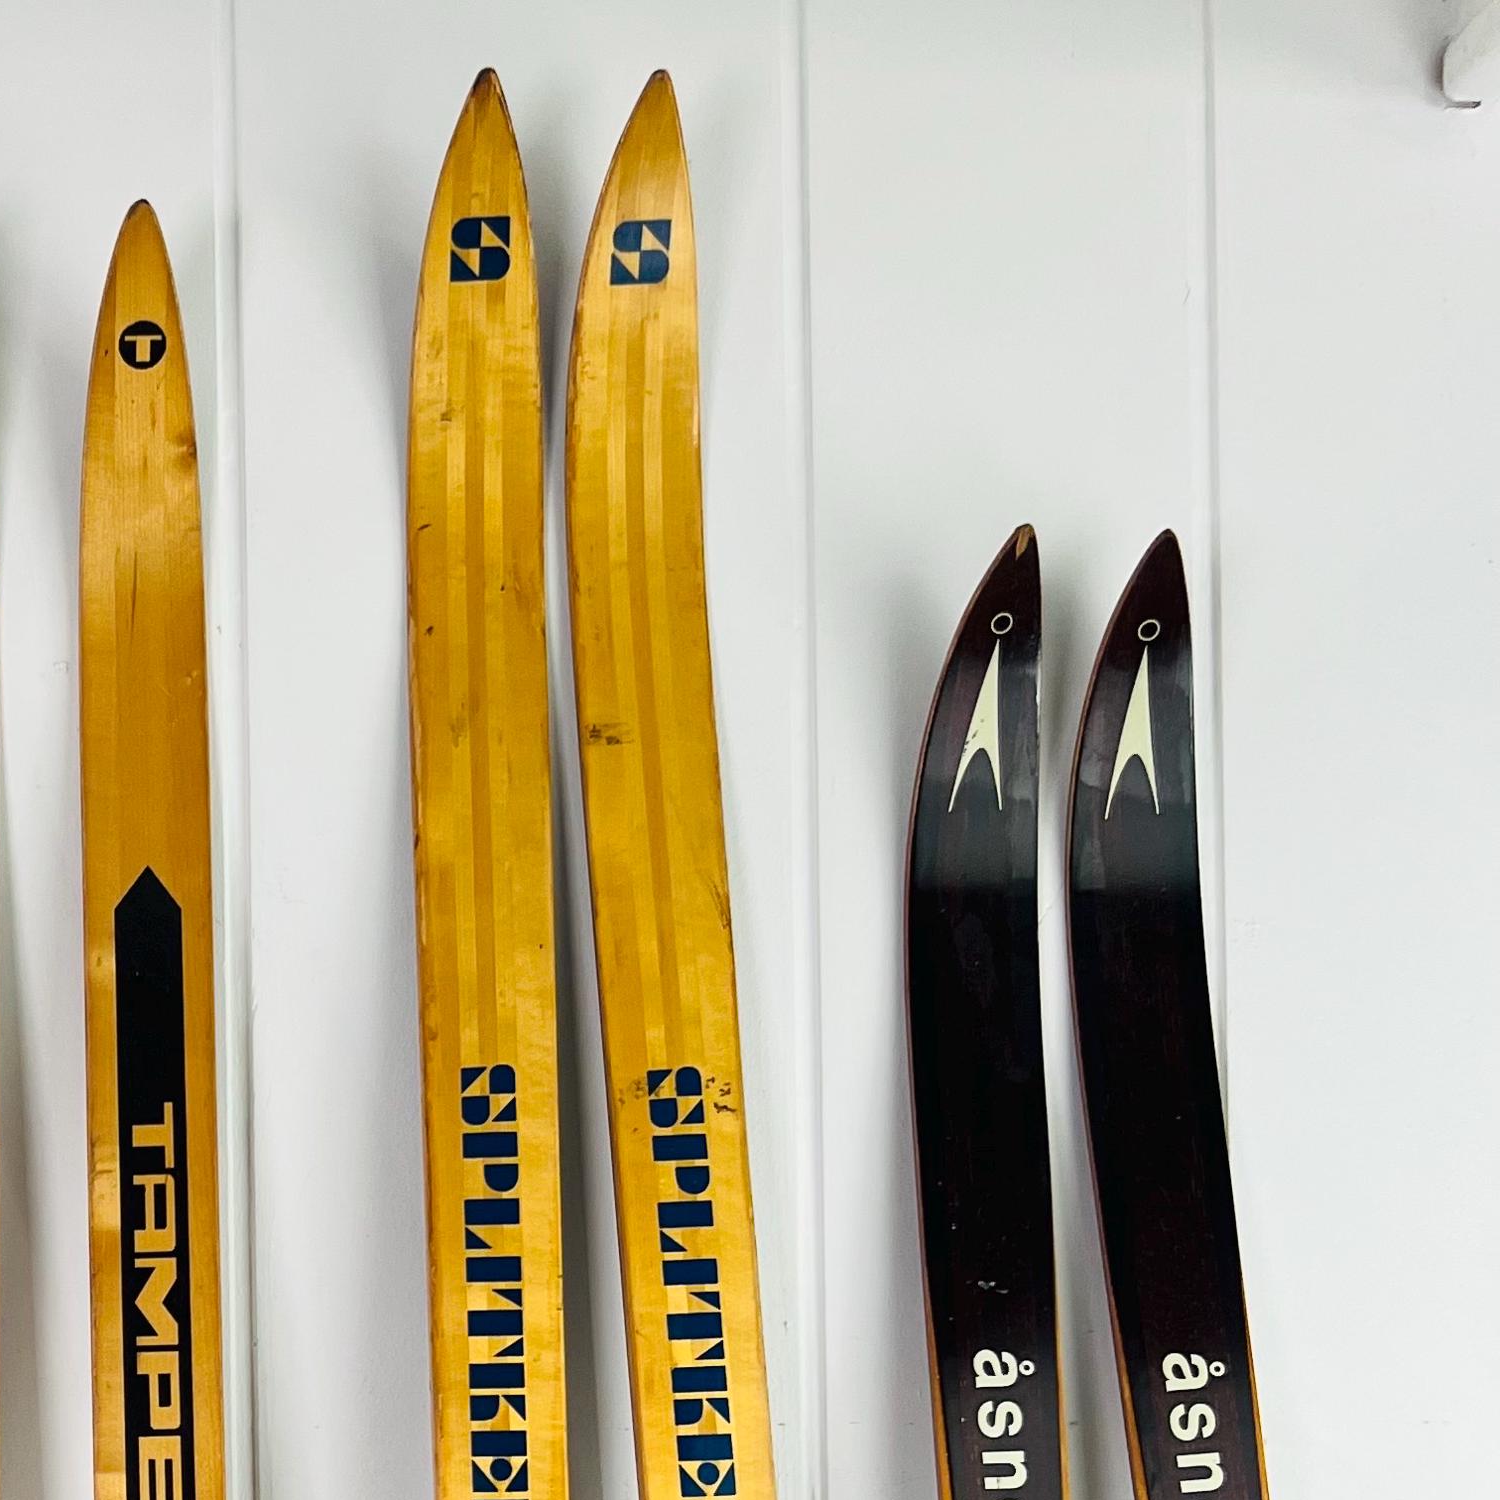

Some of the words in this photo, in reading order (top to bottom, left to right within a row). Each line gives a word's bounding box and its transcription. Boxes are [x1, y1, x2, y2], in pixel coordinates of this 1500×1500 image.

[450, 216, 511, 282] S
[610, 219, 672, 285] S
[124, 334, 162, 362] T
